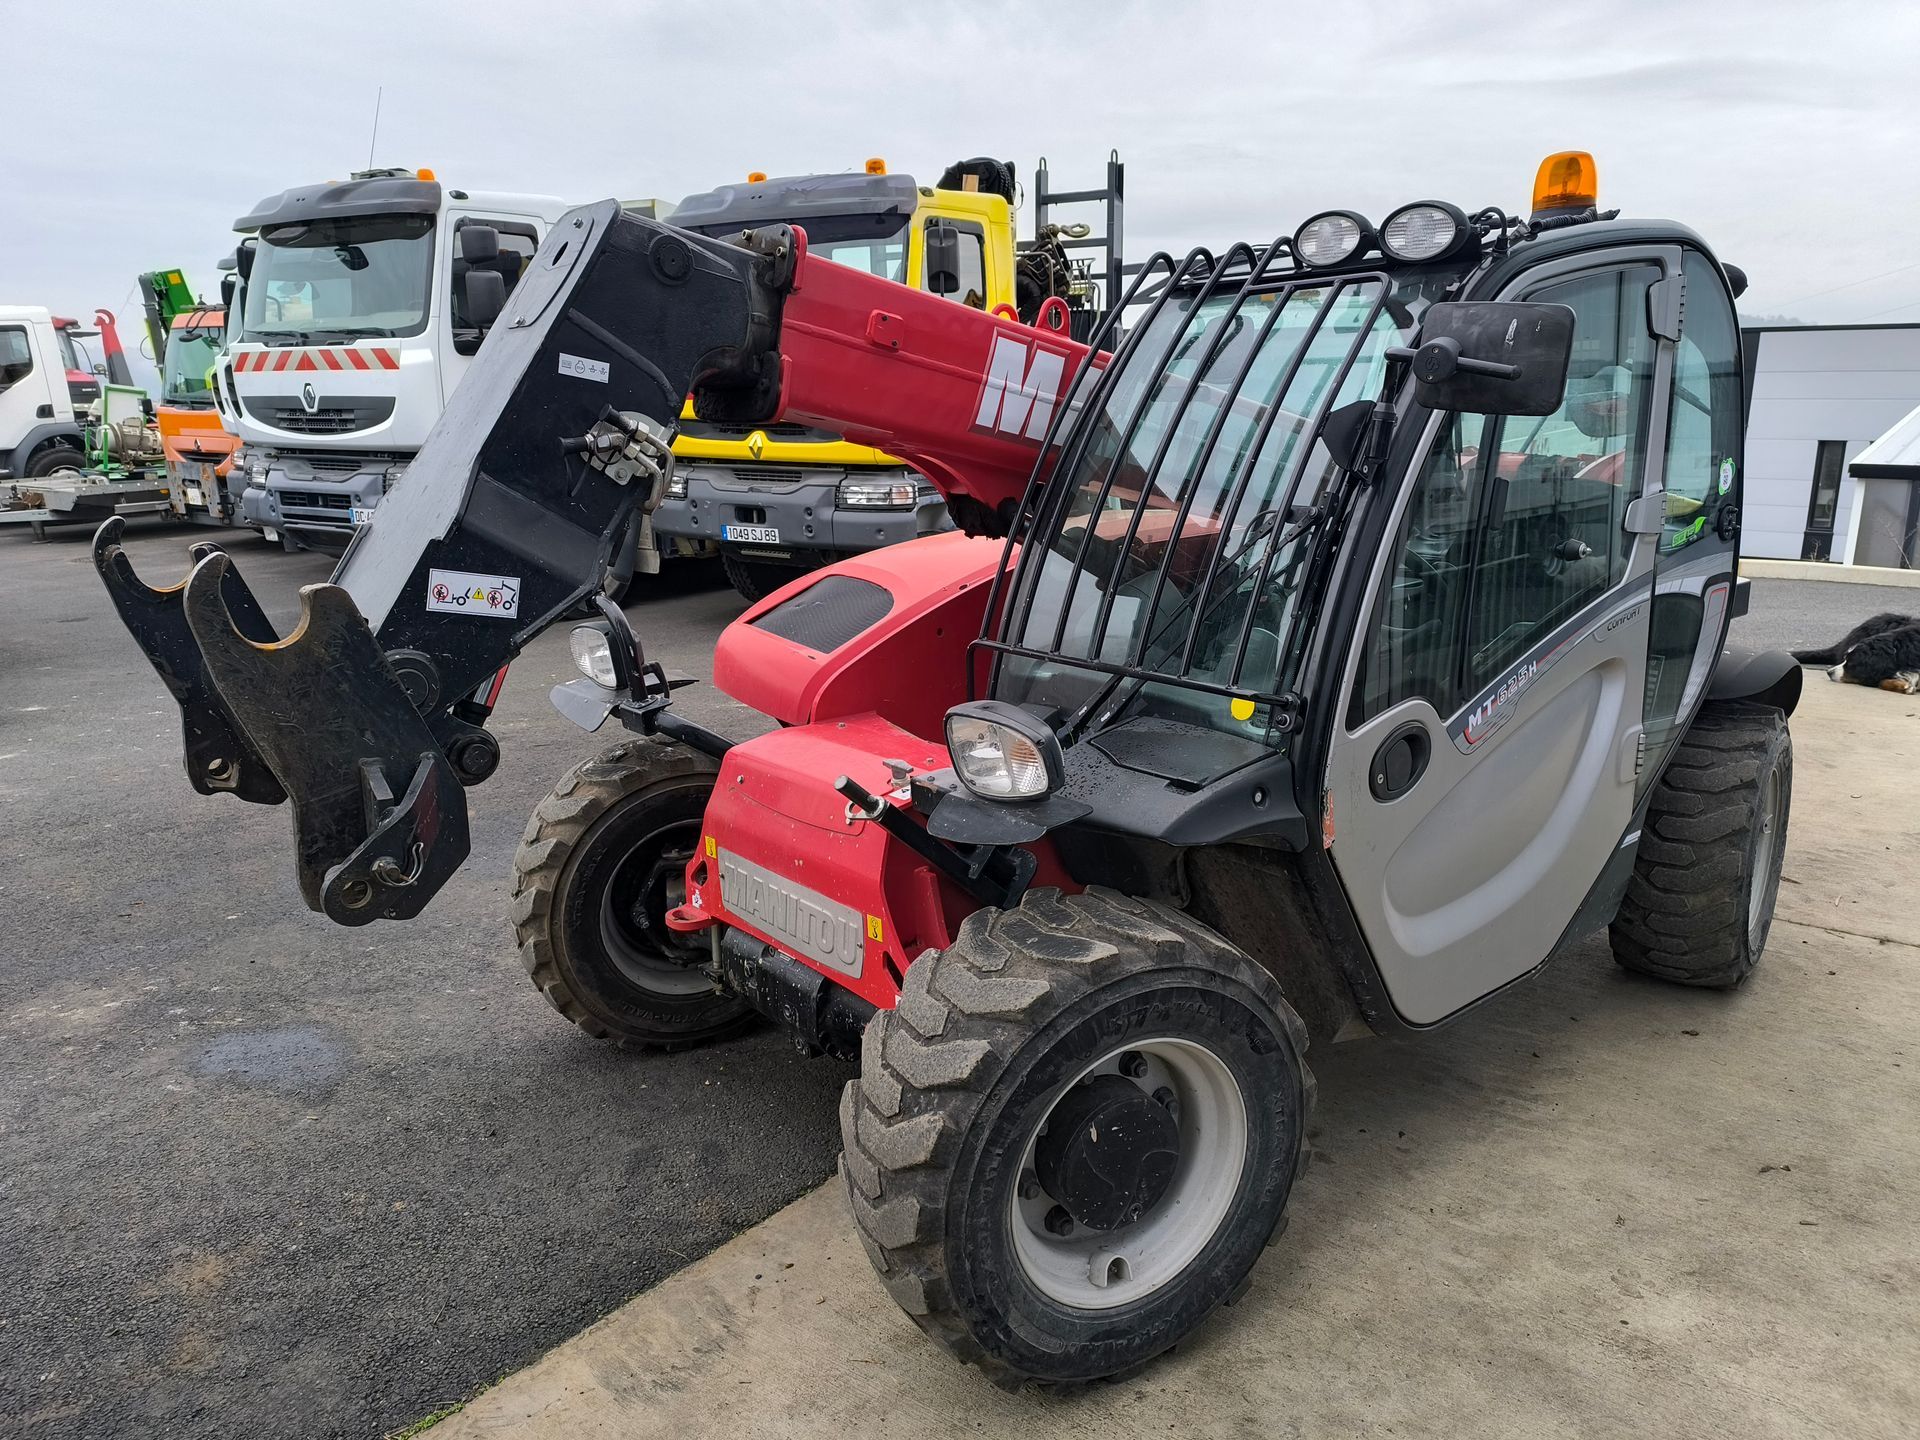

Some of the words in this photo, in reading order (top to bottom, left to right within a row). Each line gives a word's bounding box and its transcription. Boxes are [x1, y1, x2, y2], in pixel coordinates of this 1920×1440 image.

[728, 527, 750, 540] 1049
[751, 529, 763, 541] SJ
[764, 530, 777, 541] 89
[1468, 694, 1496, 733] MT
[722, 861, 859, 966] MANITOU
